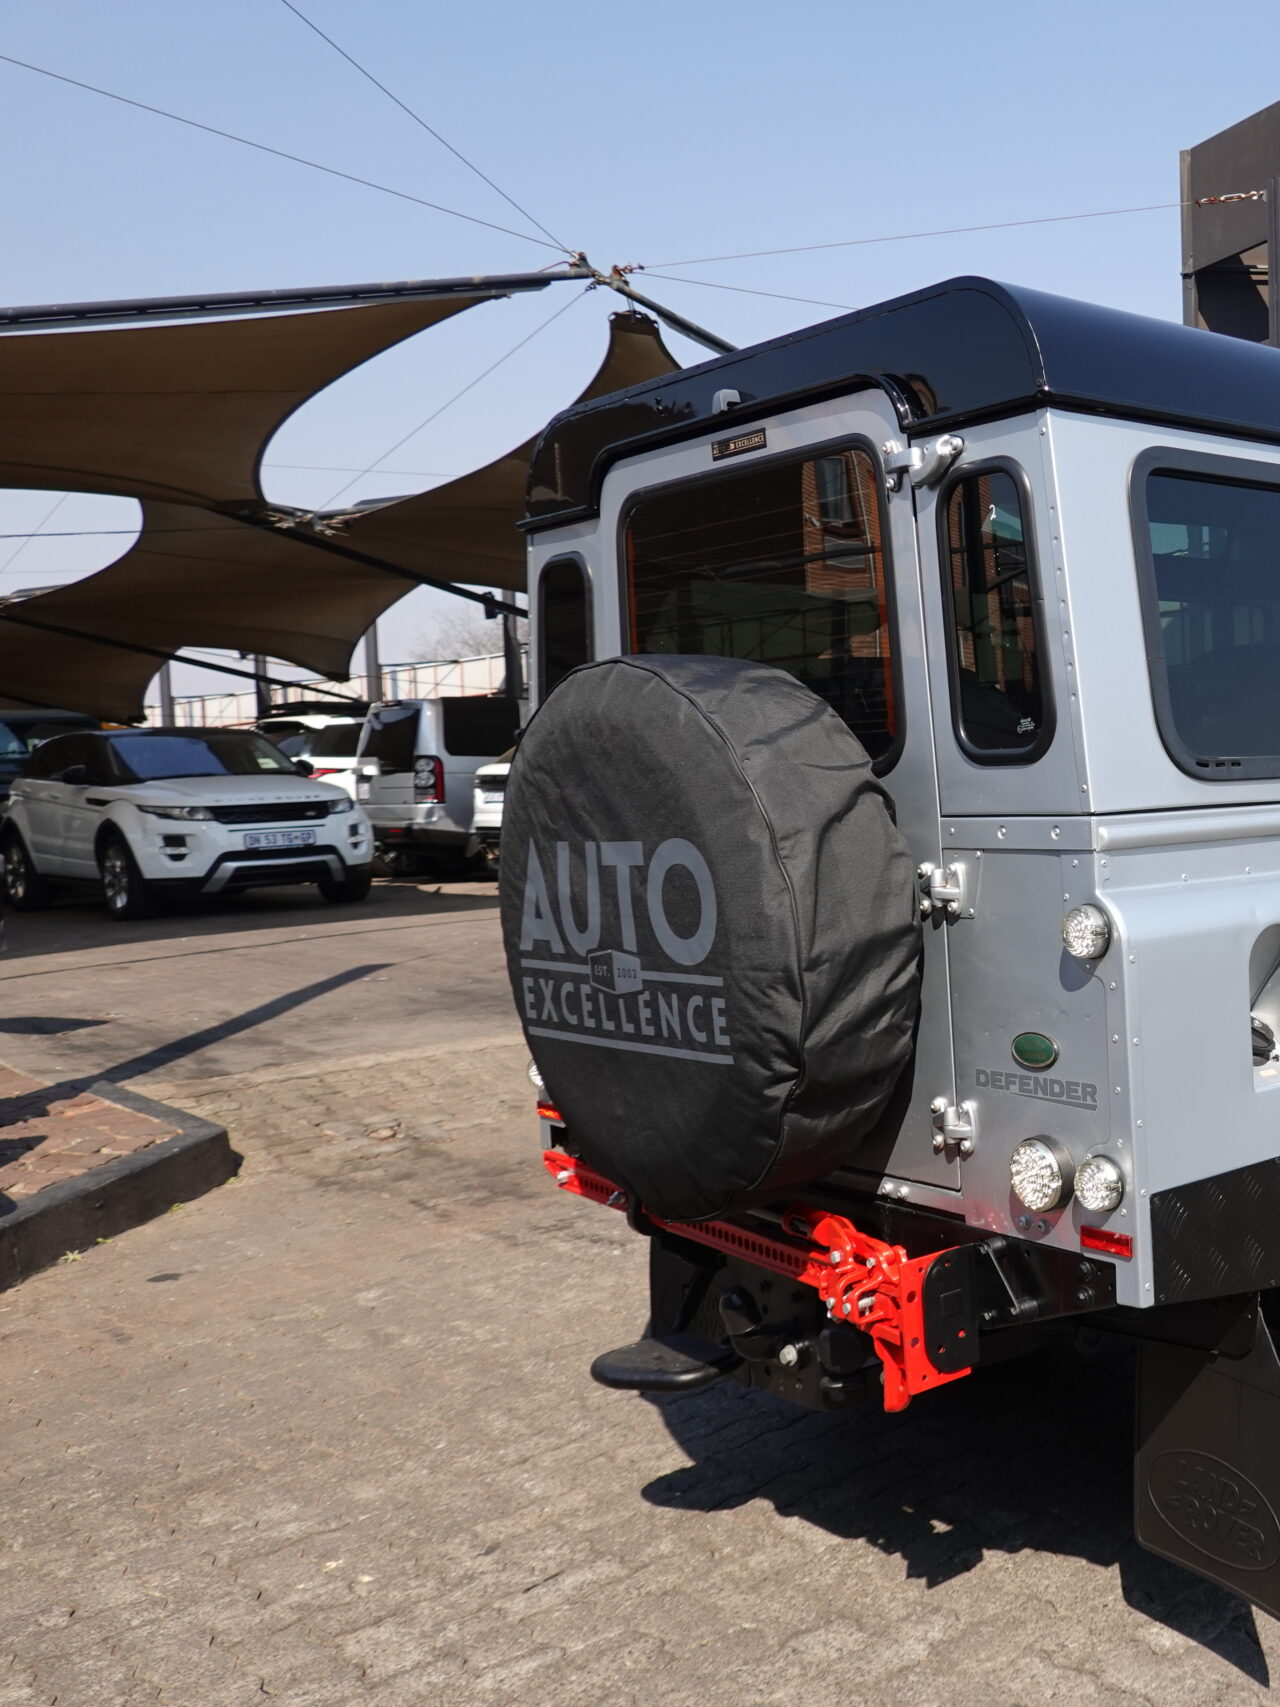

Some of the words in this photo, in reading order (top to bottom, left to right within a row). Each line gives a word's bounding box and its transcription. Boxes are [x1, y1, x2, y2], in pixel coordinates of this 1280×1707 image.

[736, 434, 764, 448] EXCELLENCE
[519, 837, 717, 966] AUTO
[593, 964, 611, 977] EST.
[616, 967, 638, 980] 2002
[522, 976, 731, 1046] EXCELLENCE
[975, 1068, 1097, 1103] DEFENDER
